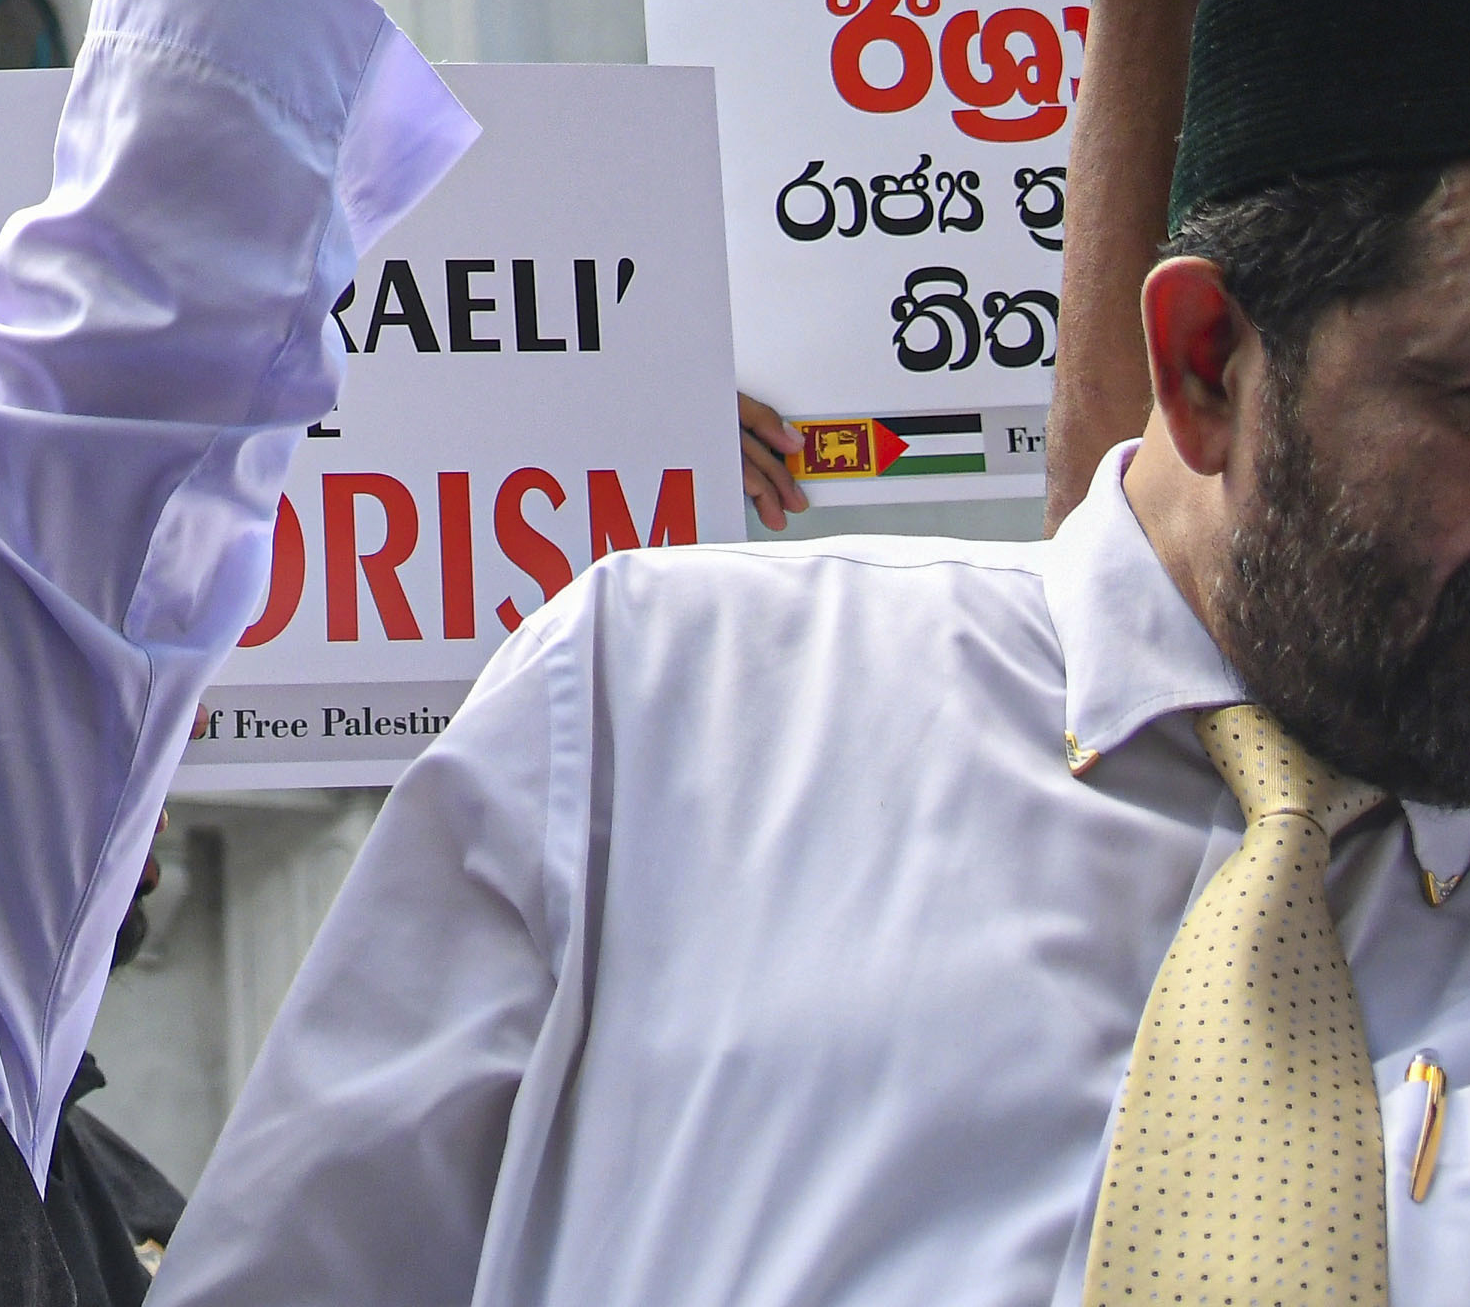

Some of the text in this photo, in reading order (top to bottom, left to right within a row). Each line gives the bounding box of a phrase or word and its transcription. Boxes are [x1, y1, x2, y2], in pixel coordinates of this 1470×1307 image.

[776, 154, 984, 241] රාජ්‍ය
[233, 709, 308, 739] Free
[321, 706, 451, 737] Palestin
